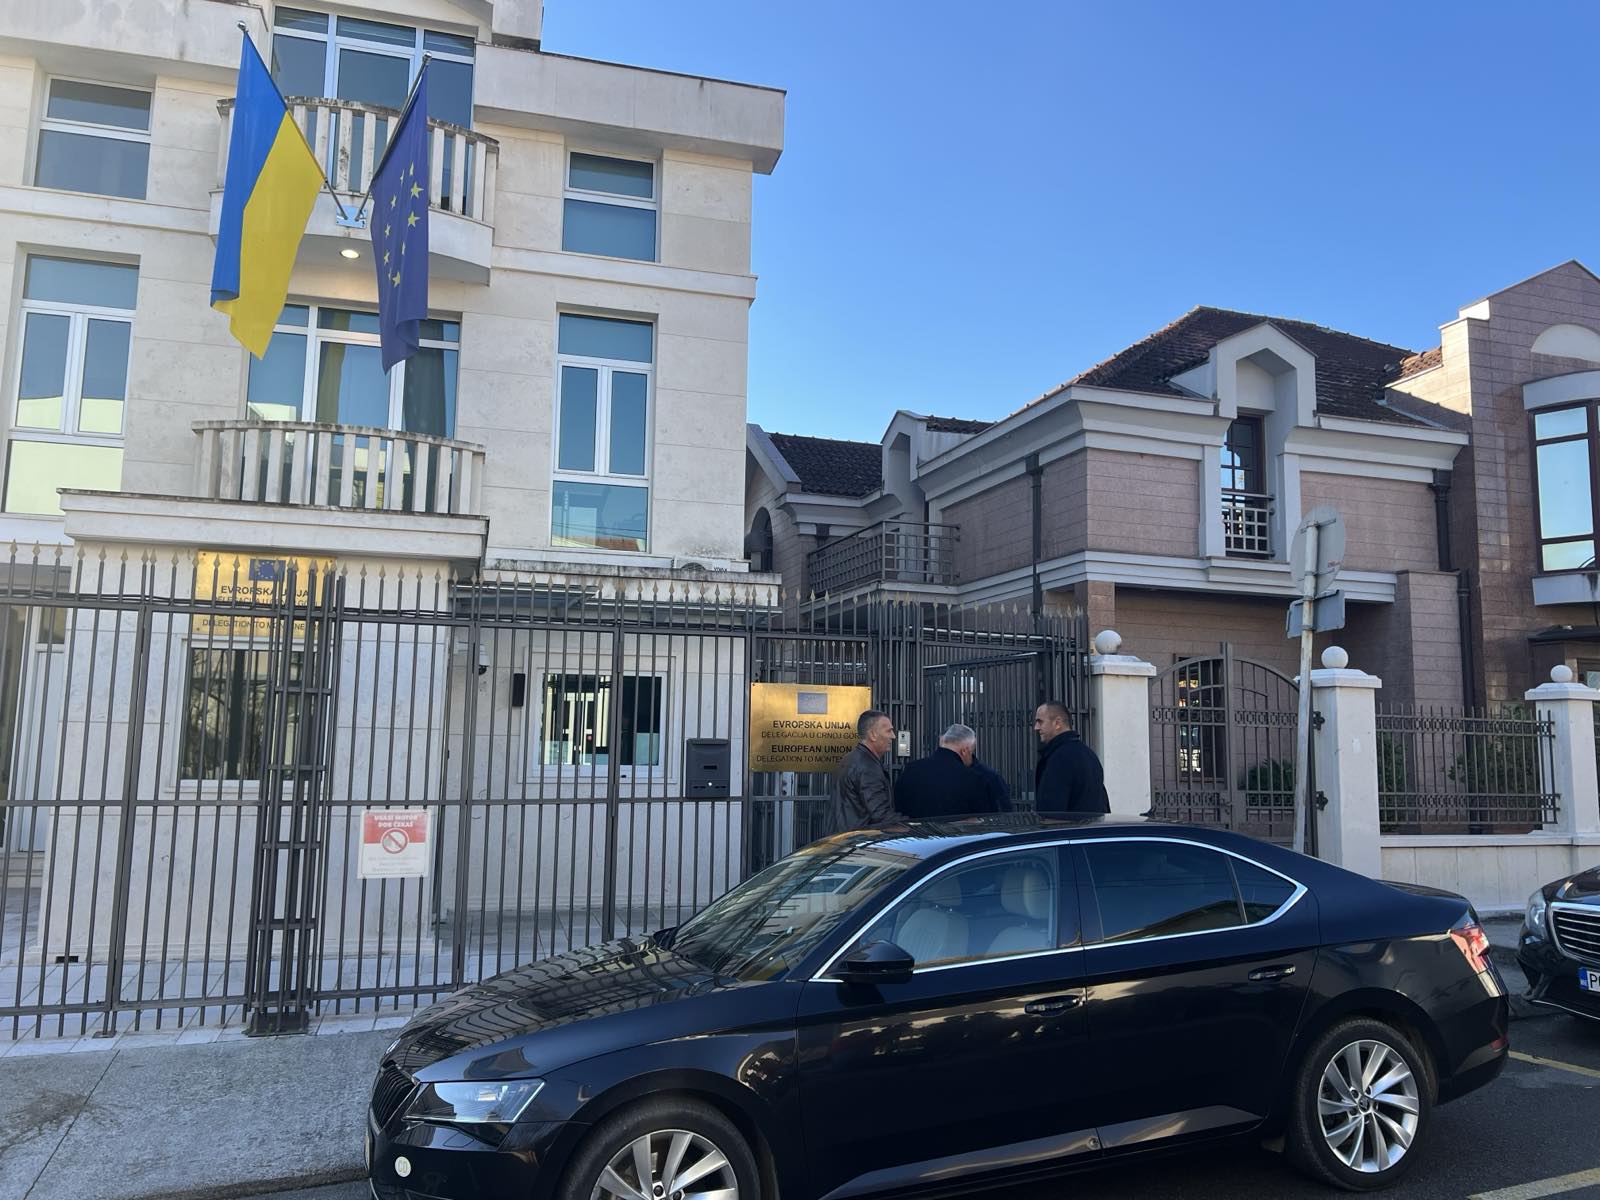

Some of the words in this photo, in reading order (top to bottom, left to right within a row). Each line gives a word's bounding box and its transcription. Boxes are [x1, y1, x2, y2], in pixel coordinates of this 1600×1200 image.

[773, 720, 823, 729] EVROPSKA
[824, 721, 851, 730] UNIJA
[843, 732, 860, 740] GOR
[771, 744, 822, 753] EUROPEAN
[824, 745, 852, 754] UNION
[756, 754, 803, 762] DELEGATION
[804, 755, 813, 763] TO
